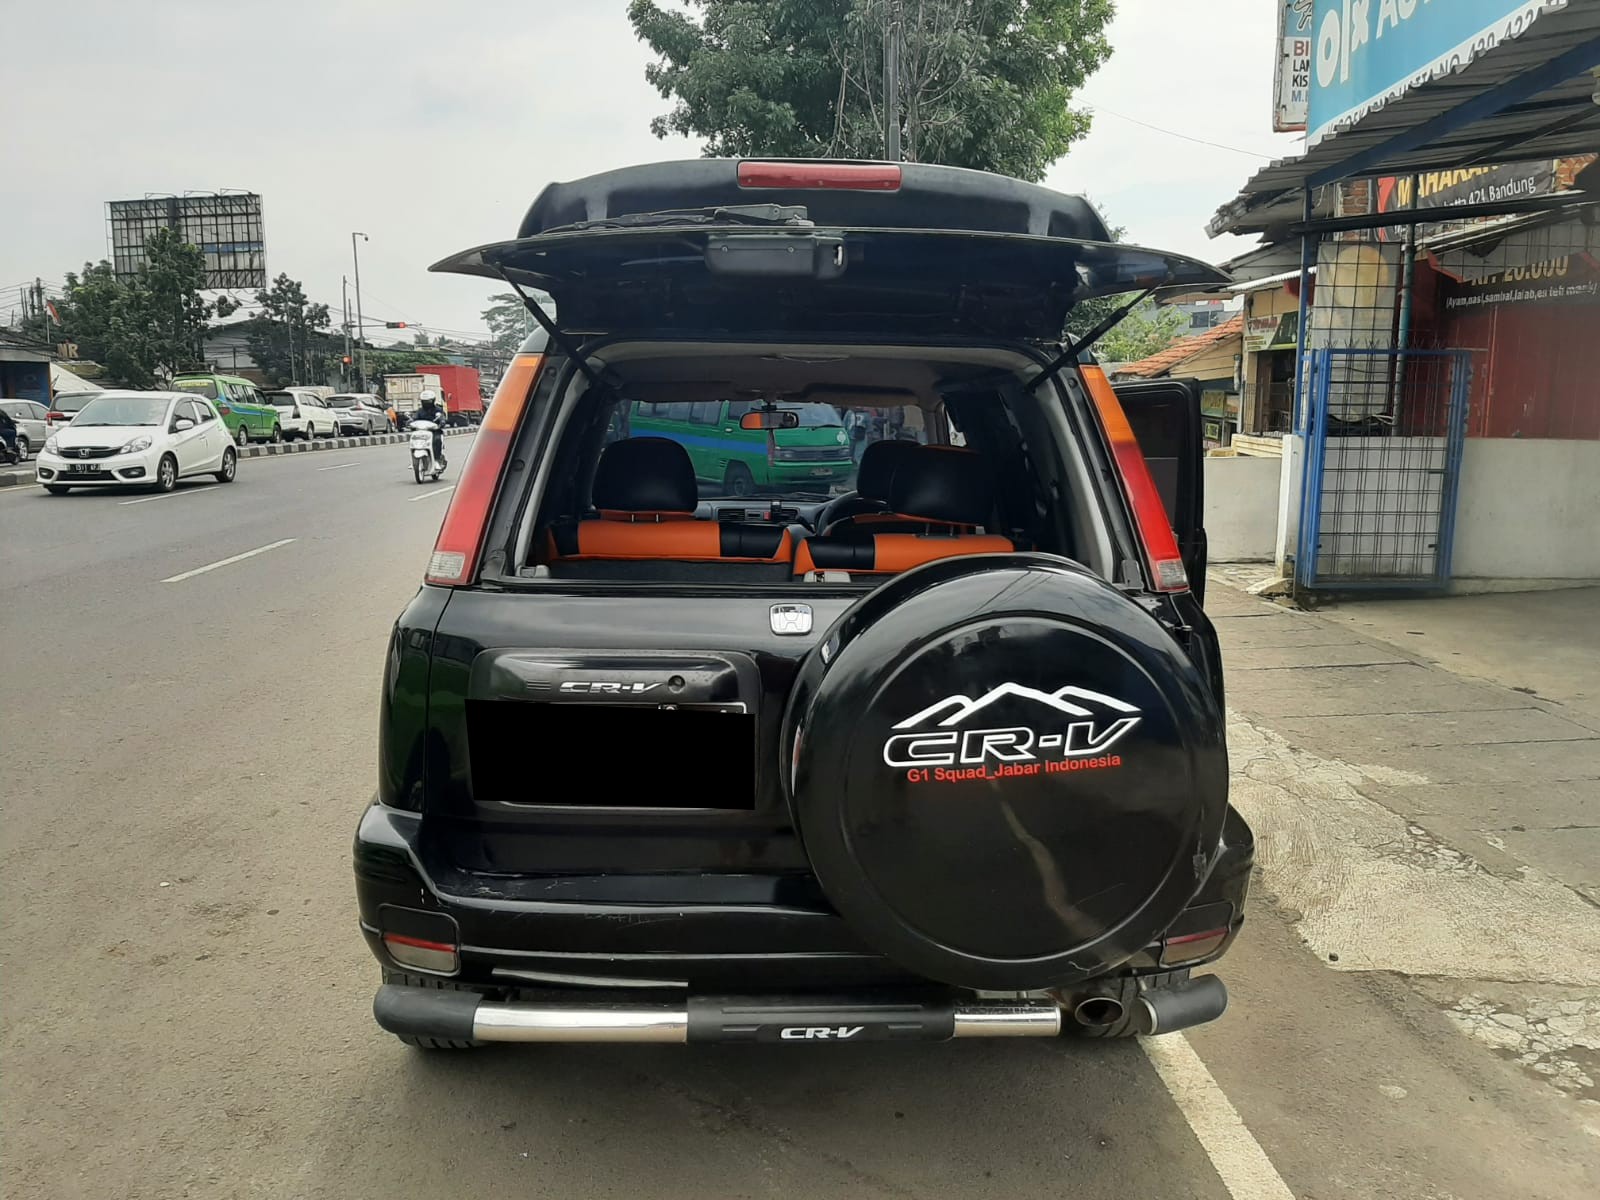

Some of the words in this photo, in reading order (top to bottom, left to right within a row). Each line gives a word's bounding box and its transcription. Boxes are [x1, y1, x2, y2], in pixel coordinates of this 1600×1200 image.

[1489, 175, 1536, 201] Bandung
[560, 682, 664, 694] CR-V
[883, 717, 1142, 767] CR-V
[907, 769, 929, 783] G1
[1045, 753, 1121, 773] Indonesia
[780, 1026, 864, 1039] CR-V
